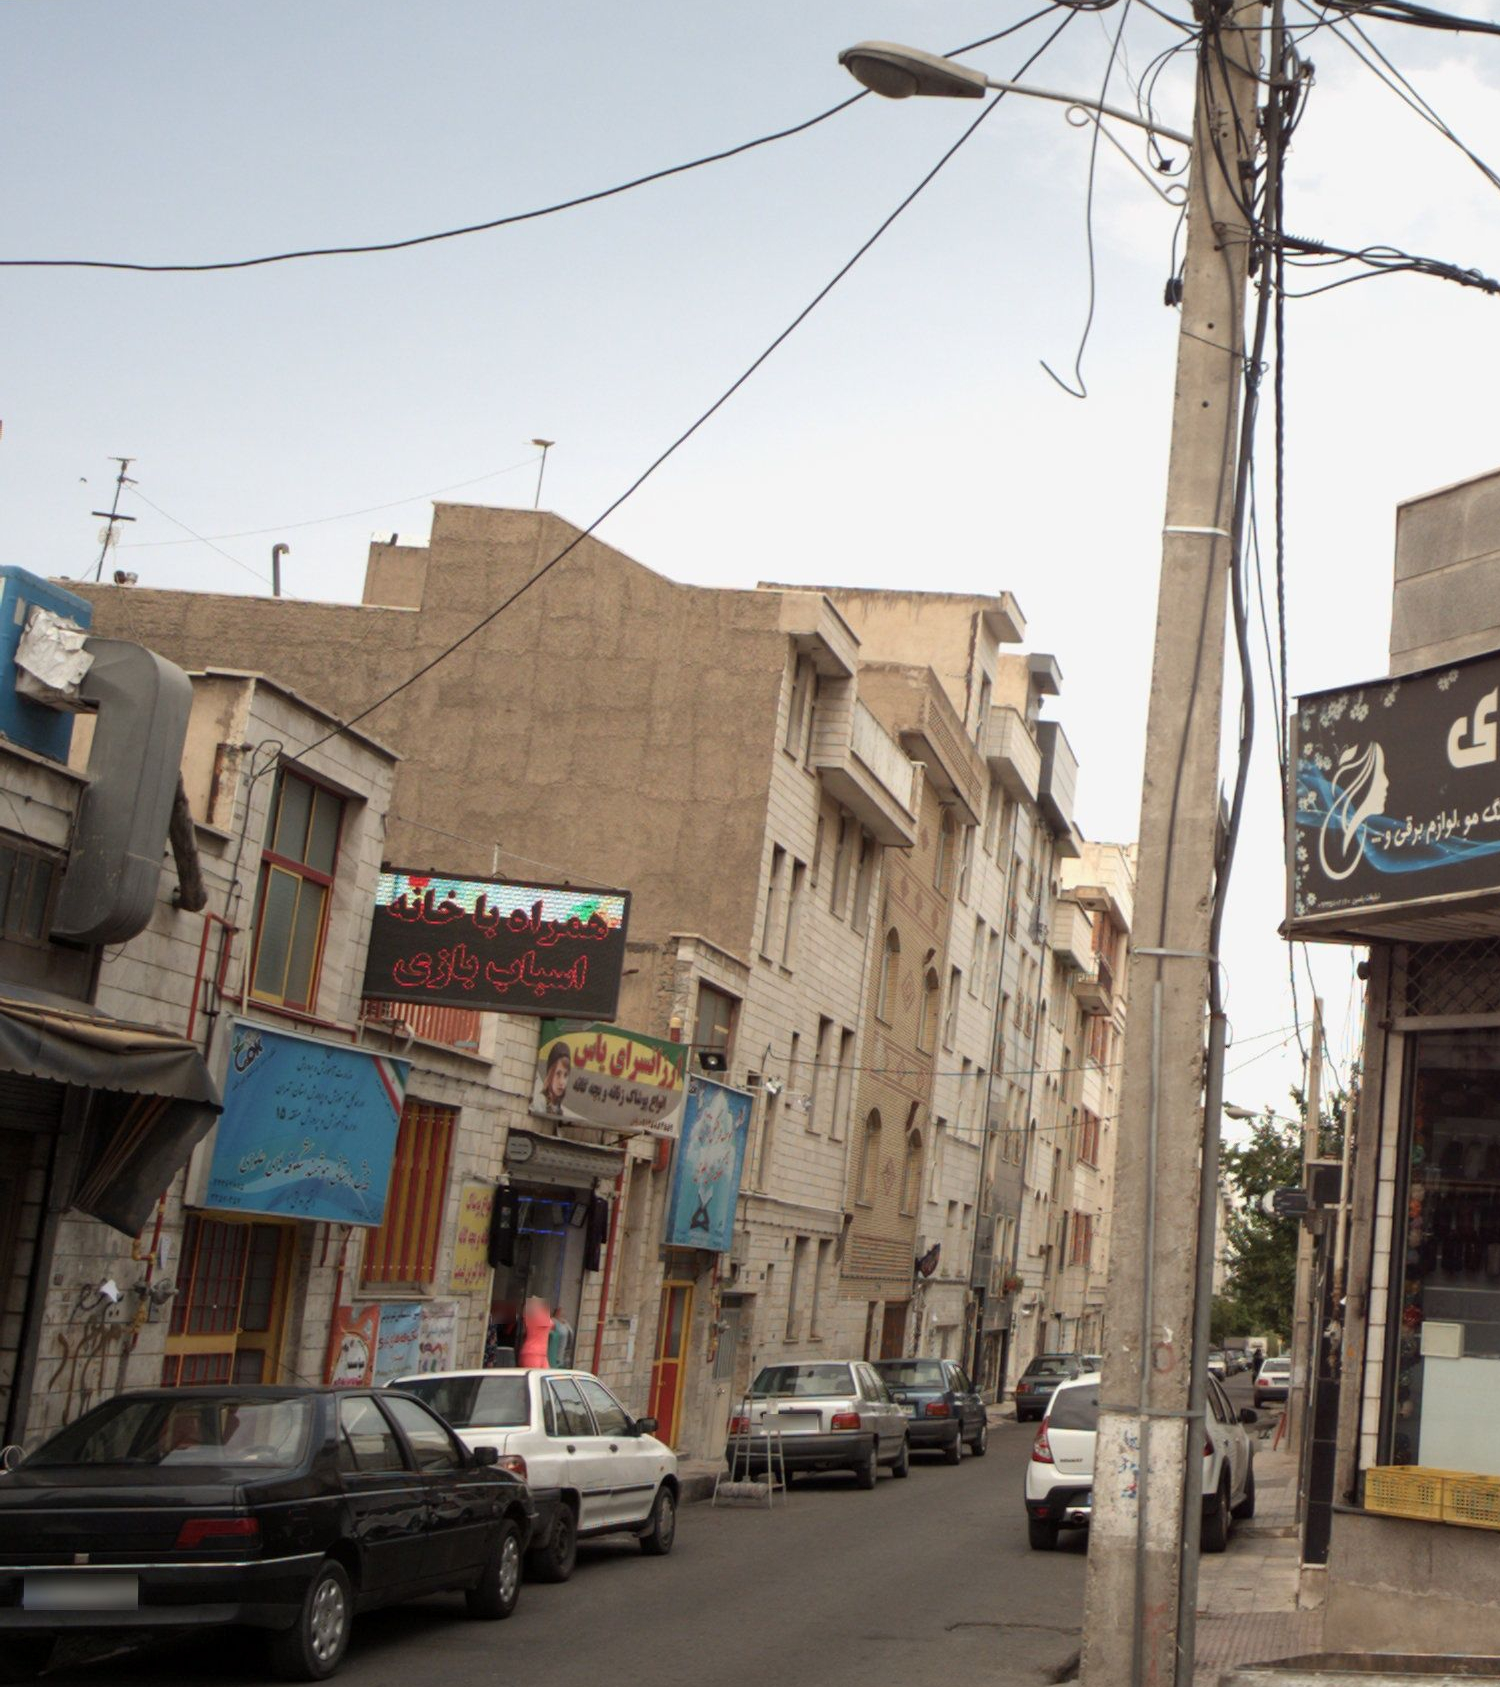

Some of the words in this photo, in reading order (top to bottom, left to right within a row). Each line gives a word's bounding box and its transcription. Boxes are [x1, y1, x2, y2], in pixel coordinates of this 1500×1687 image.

[1393, 815, 1424, 846] برقی
[1463, 811, 1479, 836] مو
[386, 886, 466, 924] خانه
[472, 892, 500, 939] با
[506, 899, 609, 947] همراه
[392, 942, 480, 990] بازی
[485, 949, 589, 997] اسباب
